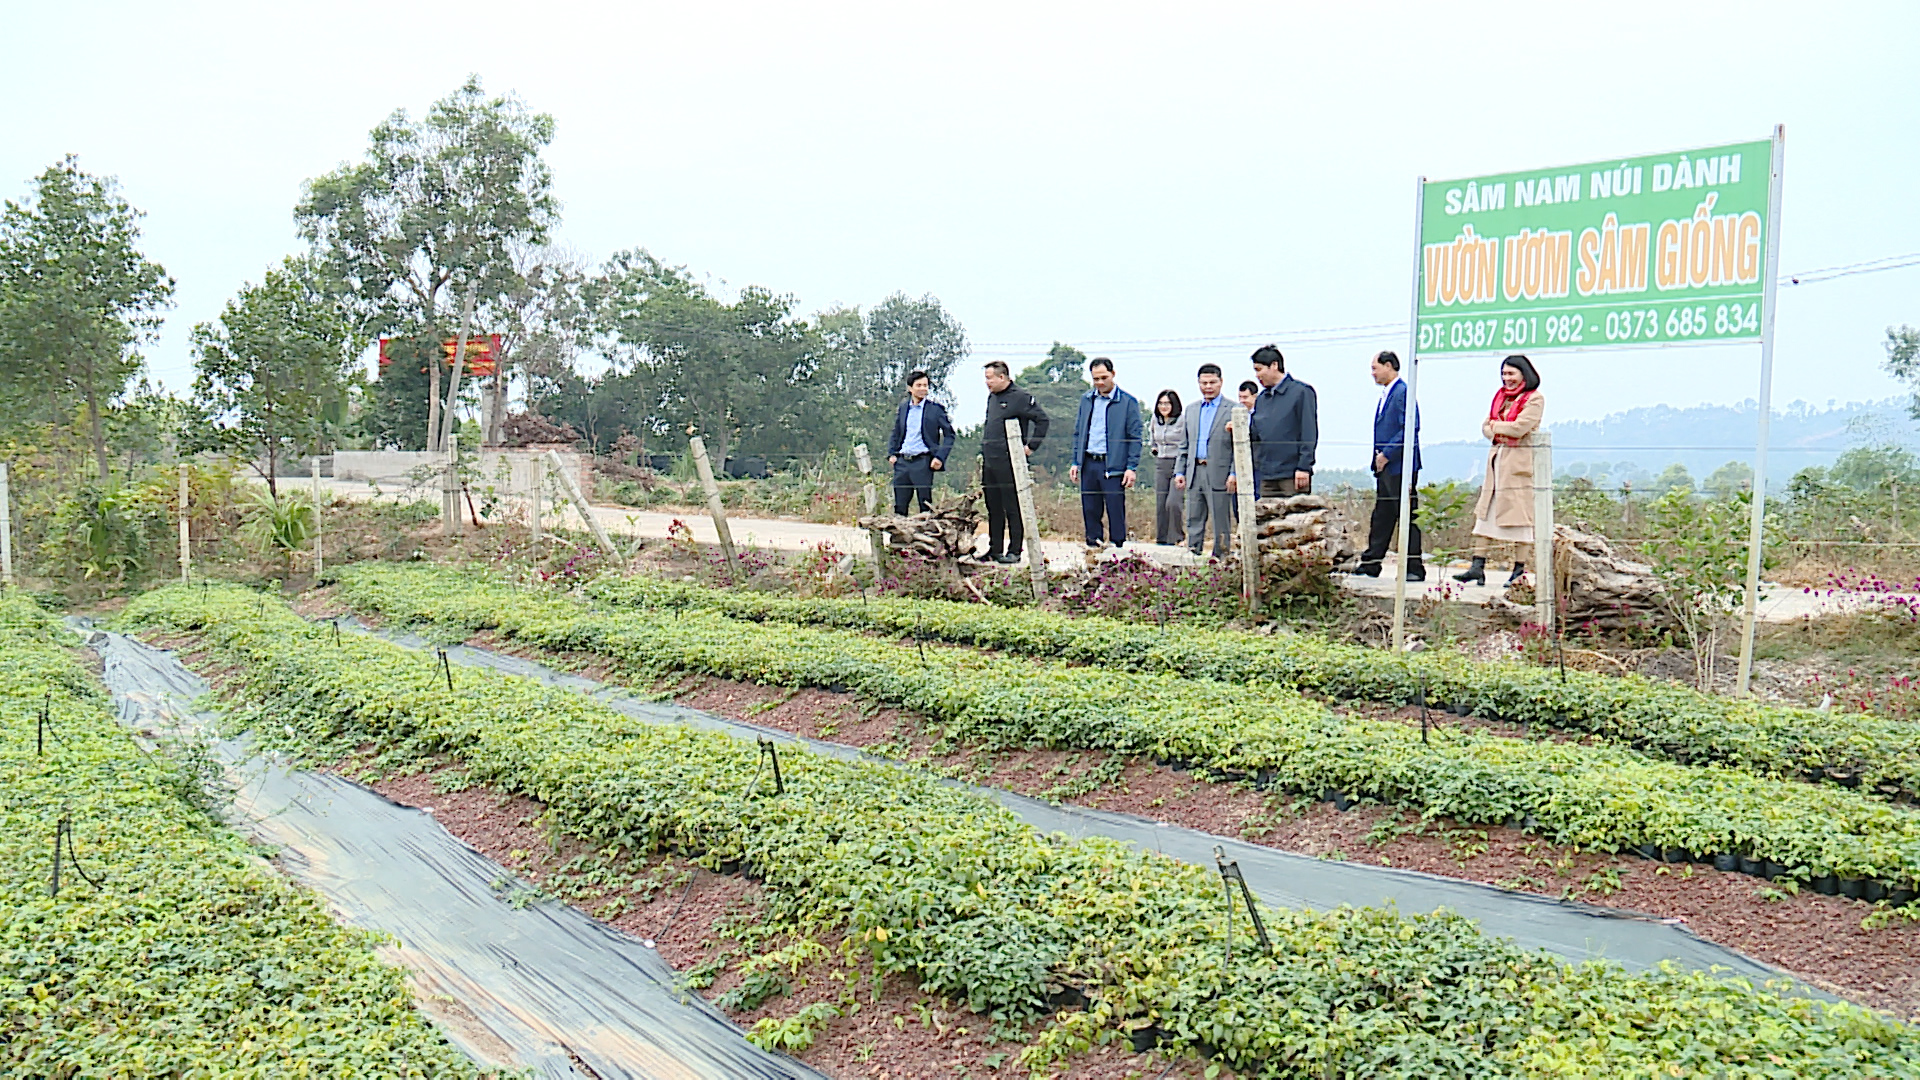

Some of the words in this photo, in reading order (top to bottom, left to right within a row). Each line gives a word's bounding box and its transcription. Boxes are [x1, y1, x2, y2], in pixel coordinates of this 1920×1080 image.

[1444, 181, 1506, 215] SÂM
[1514, 173, 1581, 208] NAM
[1590, 162, 1642, 199] NÚI
[1652, 153, 1742, 192] DÀNH
[1425, 224, 1498, 306] VƯỜN
[1503, 228, 1572, 302] ƯƠM
[1577, 213, 1650, 296] SÂM
[1655, 192, 1761, 291] GIỐNG
[1419, 323, 1445, 349] ĐT:
[1451, 319, 1498, 348] 0387
[1503, 317, 1538, 345] 501
[1545, 313, 1583, 343] 982
[1605, 309, 1659, 340] 0373
[1665, 306, 1707, 337] 685
[1714, 302, 1758, 334] 834
